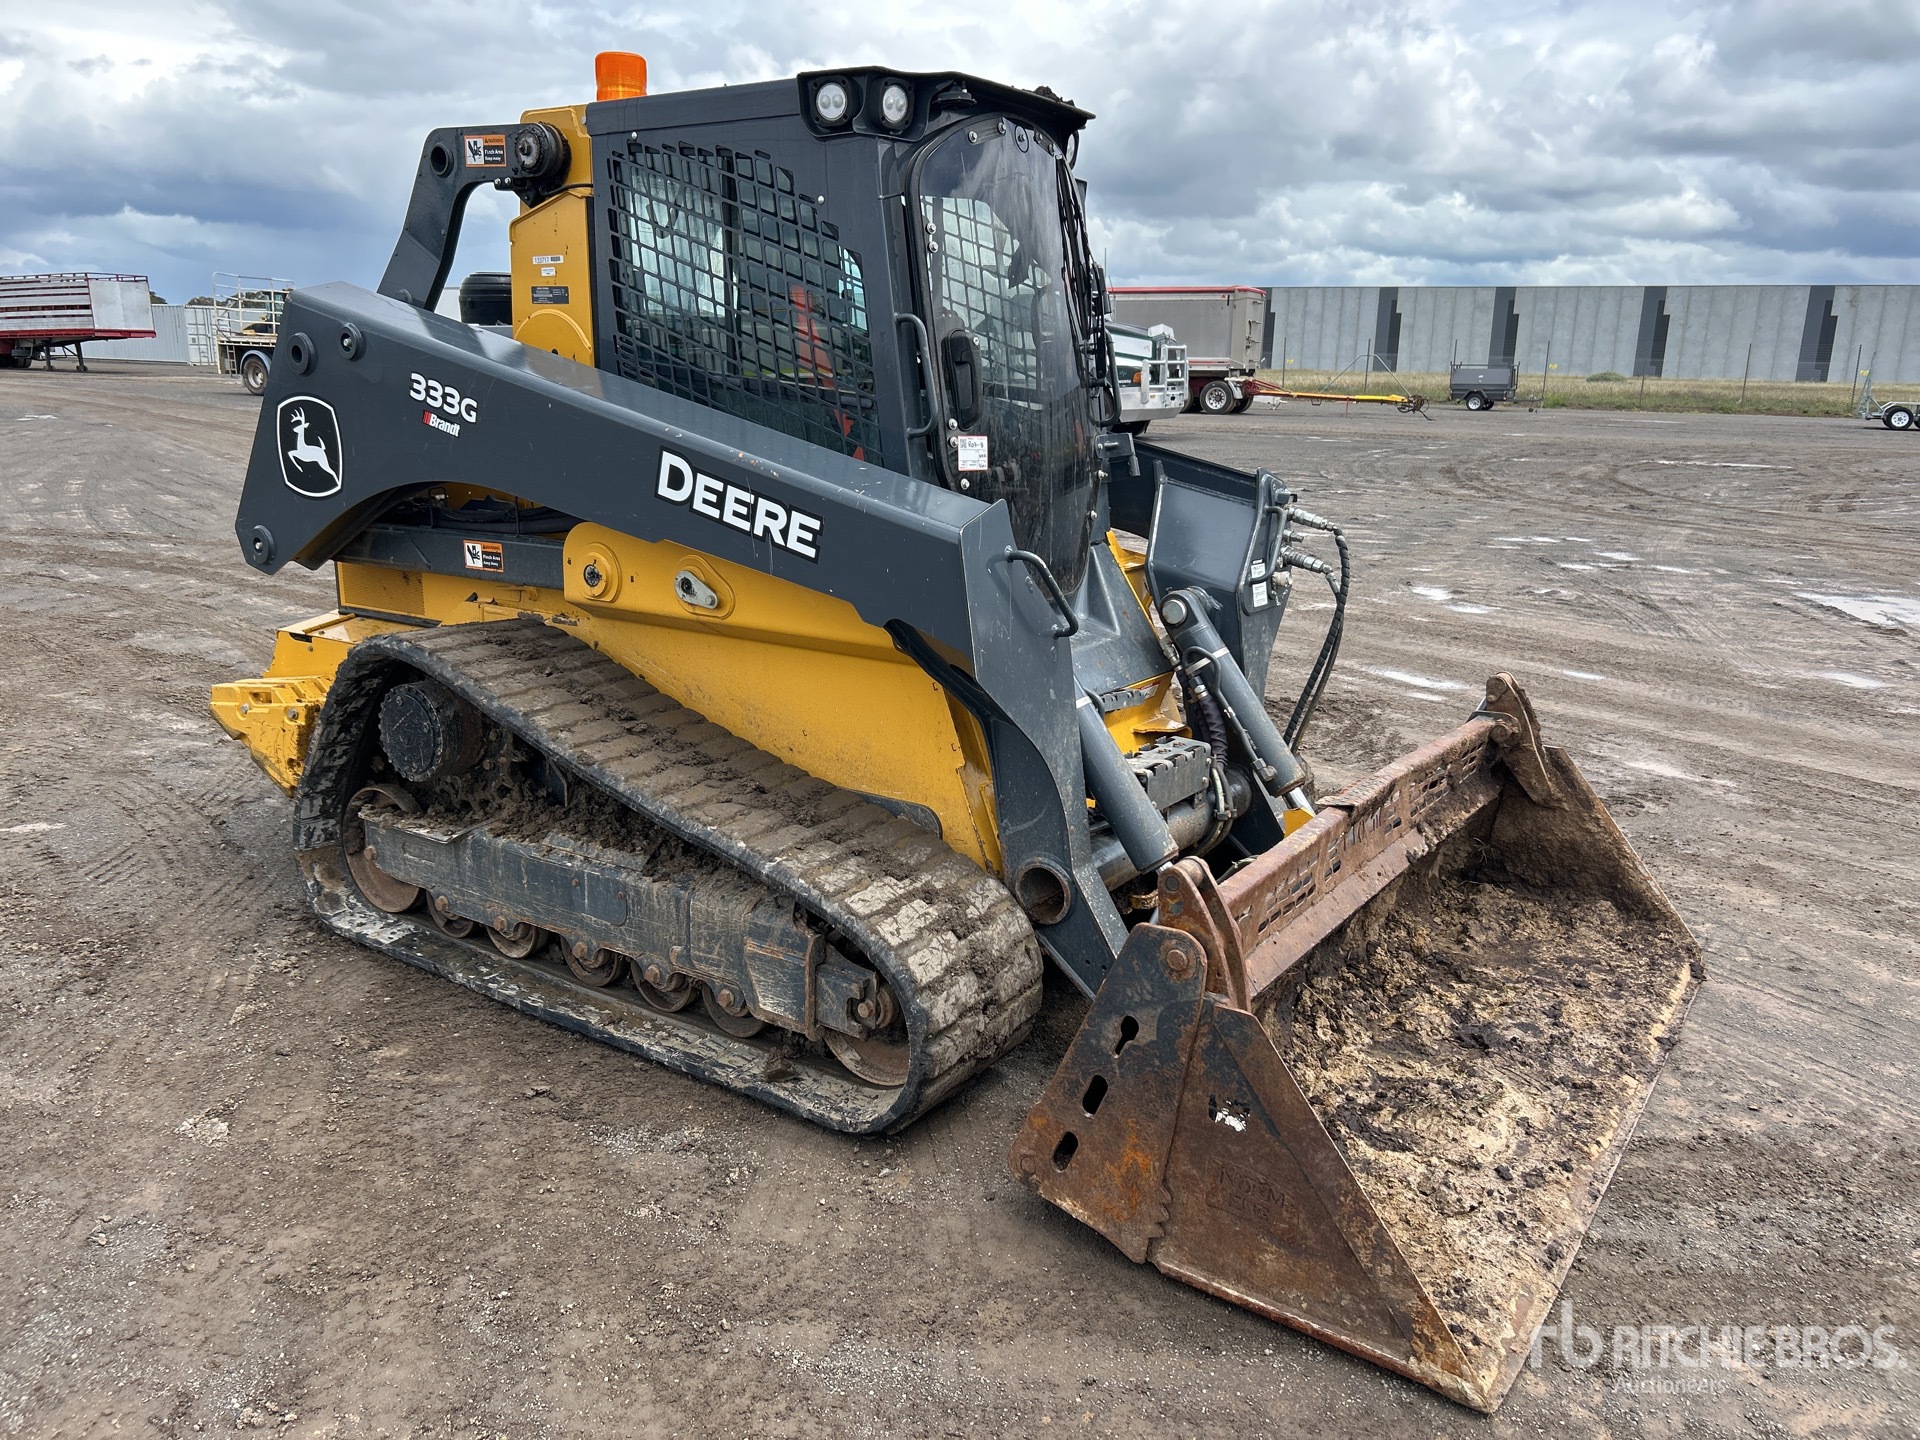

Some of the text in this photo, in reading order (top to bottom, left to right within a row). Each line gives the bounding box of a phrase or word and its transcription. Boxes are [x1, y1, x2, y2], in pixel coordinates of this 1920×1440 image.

[410, 372, 478, 423] 333G
[429, 413, 461, 437] Brandt
[657, 451, 821, 559] DEERE
